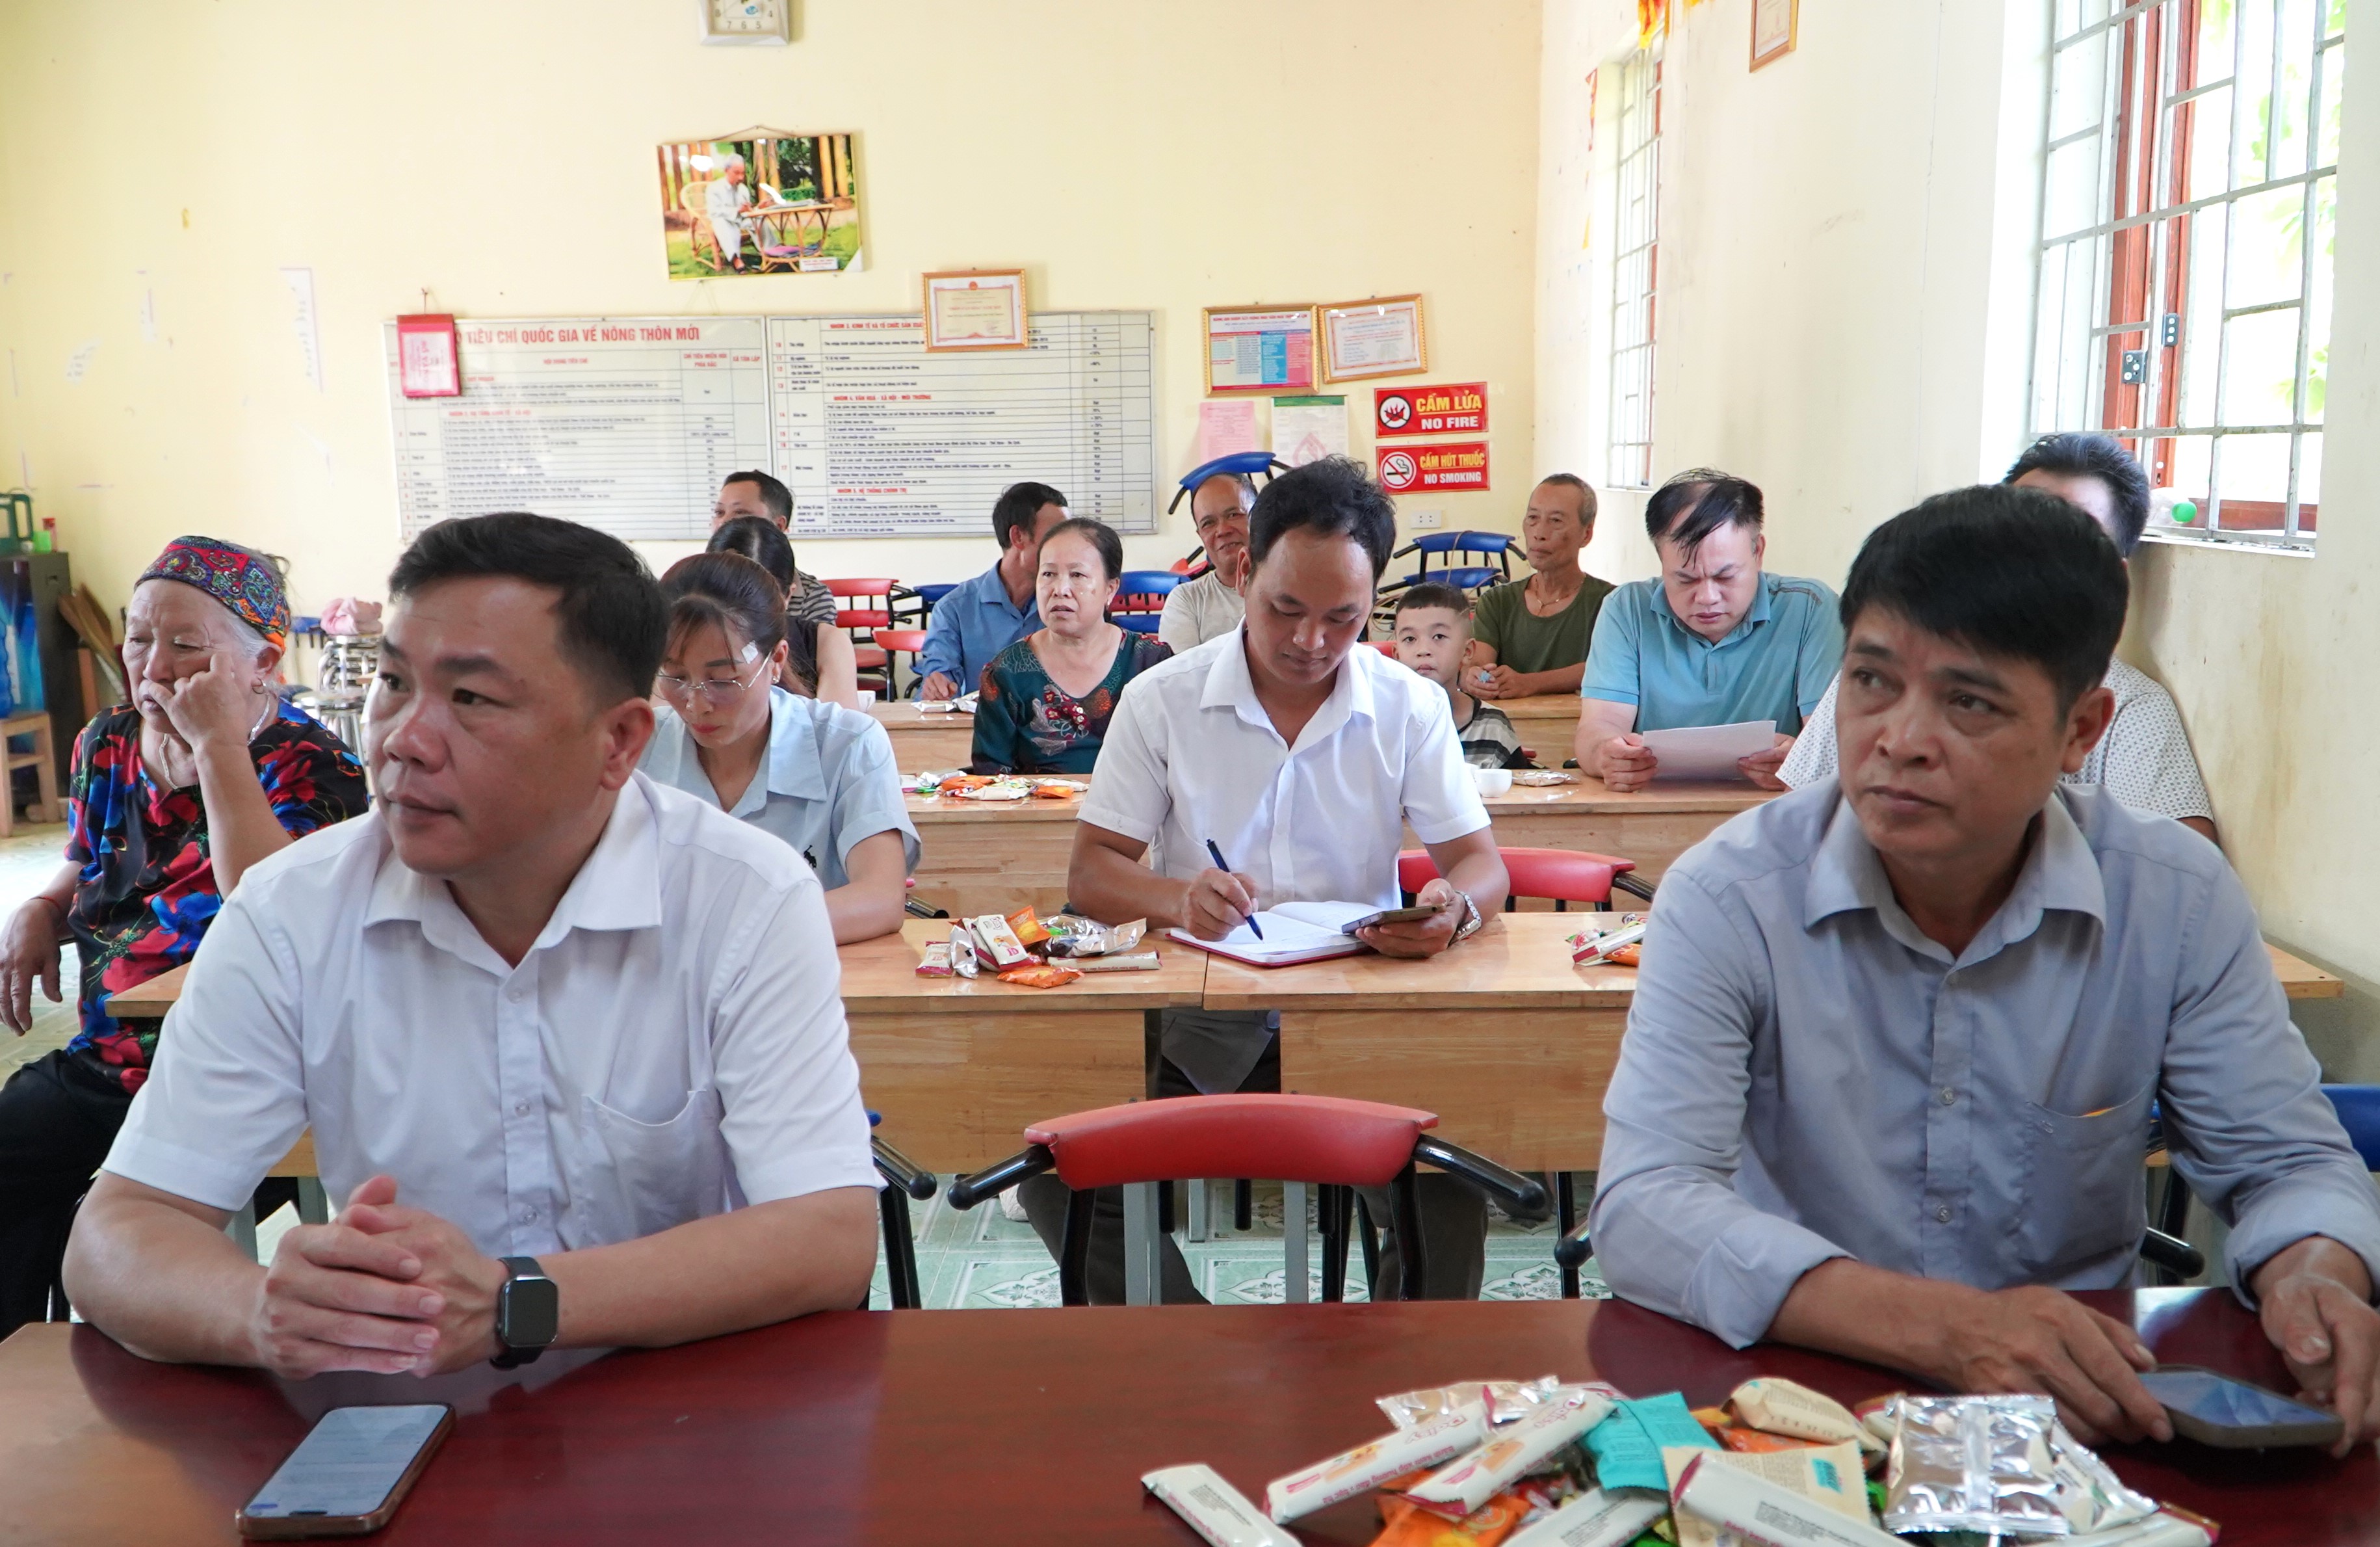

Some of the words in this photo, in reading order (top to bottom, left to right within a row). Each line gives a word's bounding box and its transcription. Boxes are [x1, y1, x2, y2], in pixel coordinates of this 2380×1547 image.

[467, 328, 492, 344] TIÊU
[497, 327, 517, 344] CHÍ
[521, 325, 555, 345] QUỐC
[558, 329, 579, 343] GIA
[582, 325, 597, 342] VỀ
[601, 326, 636, 342] NÔNG
[640, 325, 672, 341] THÔN
[676, 324, 700, 341] MỚI
[1416, 393, 1450, 412] CẤM
[1454, 390, 1482, 410] LỬA
[1421, 417, 1443, 430] NO
[1446, 416, 1479, 429] FIRE
[1419, 452, 1439, 469] CẤM
[1441, 451, 1456, 468] HÚT
[1459, 449, 1485, 466] THUỐC
[1424, 473, 1437, 484] NO
[1439, 471, 1482, 483] SMOKING
